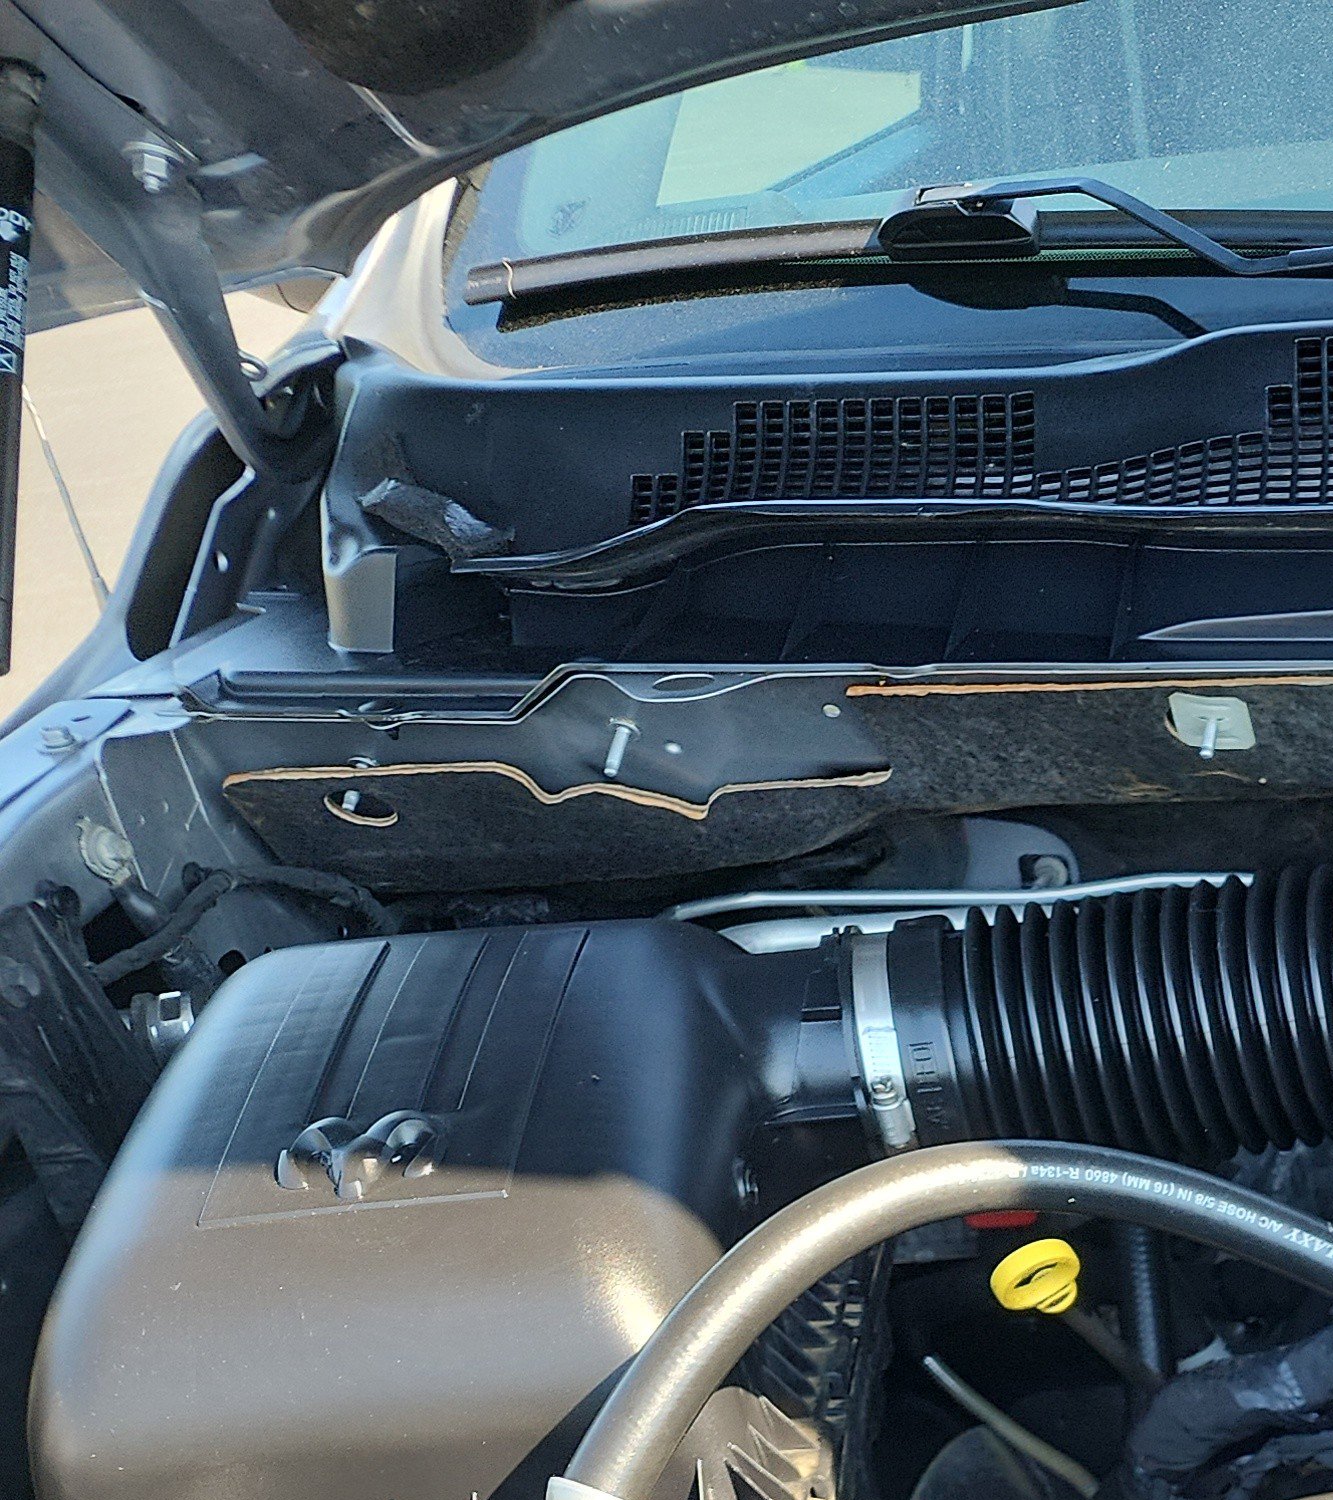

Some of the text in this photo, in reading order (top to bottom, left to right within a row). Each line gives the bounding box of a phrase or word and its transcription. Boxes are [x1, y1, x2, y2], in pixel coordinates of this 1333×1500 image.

[1031, 1165, 1080, 1180] R-134a
[1084, 1168, 1118, 1185] 4860
[1122, 1171, 1151, 1191] MM)
[1154, 1179, 1175, 1197] (16
[1175, 1186, 1193, 1203] IN
[1195, 1192, 1216, 1210] 5/8
[1218, 1199, 1257, 1225] HOSE
[1258, 1214, 1283, 1233] A/C
